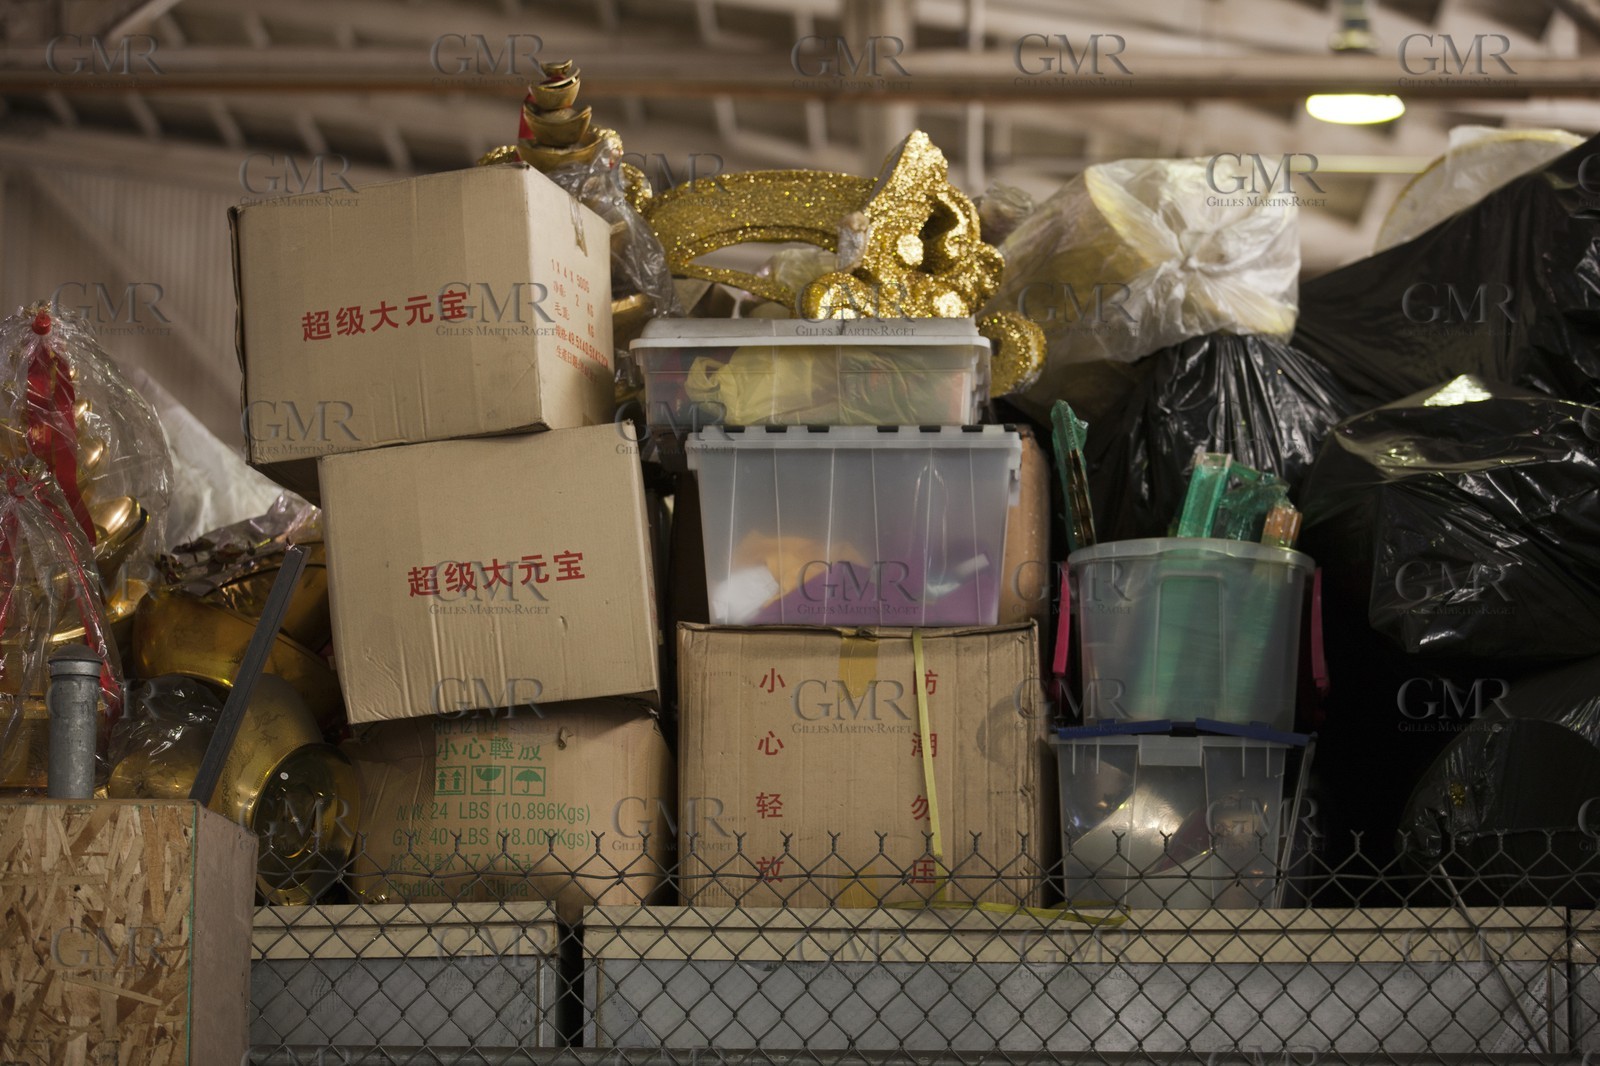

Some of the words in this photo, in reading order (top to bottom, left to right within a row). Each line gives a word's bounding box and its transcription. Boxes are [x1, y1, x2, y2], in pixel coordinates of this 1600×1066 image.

[575, 293, 580, 308] 2
[301, 289, 467, 343] 超级大元宝
[406, 549, 586, 598] 超级大元宝
[430, 802, 448, 820] 24
[459, 801, 490, 820] LBS
[495, 801, 590, 826] (10.896Kgs)
[429, 827, 448, 846] 40
[459, 827, 490, 846] LBS
[463, 853, 481, 871] 17
[386, 880, 446, 897] Product
